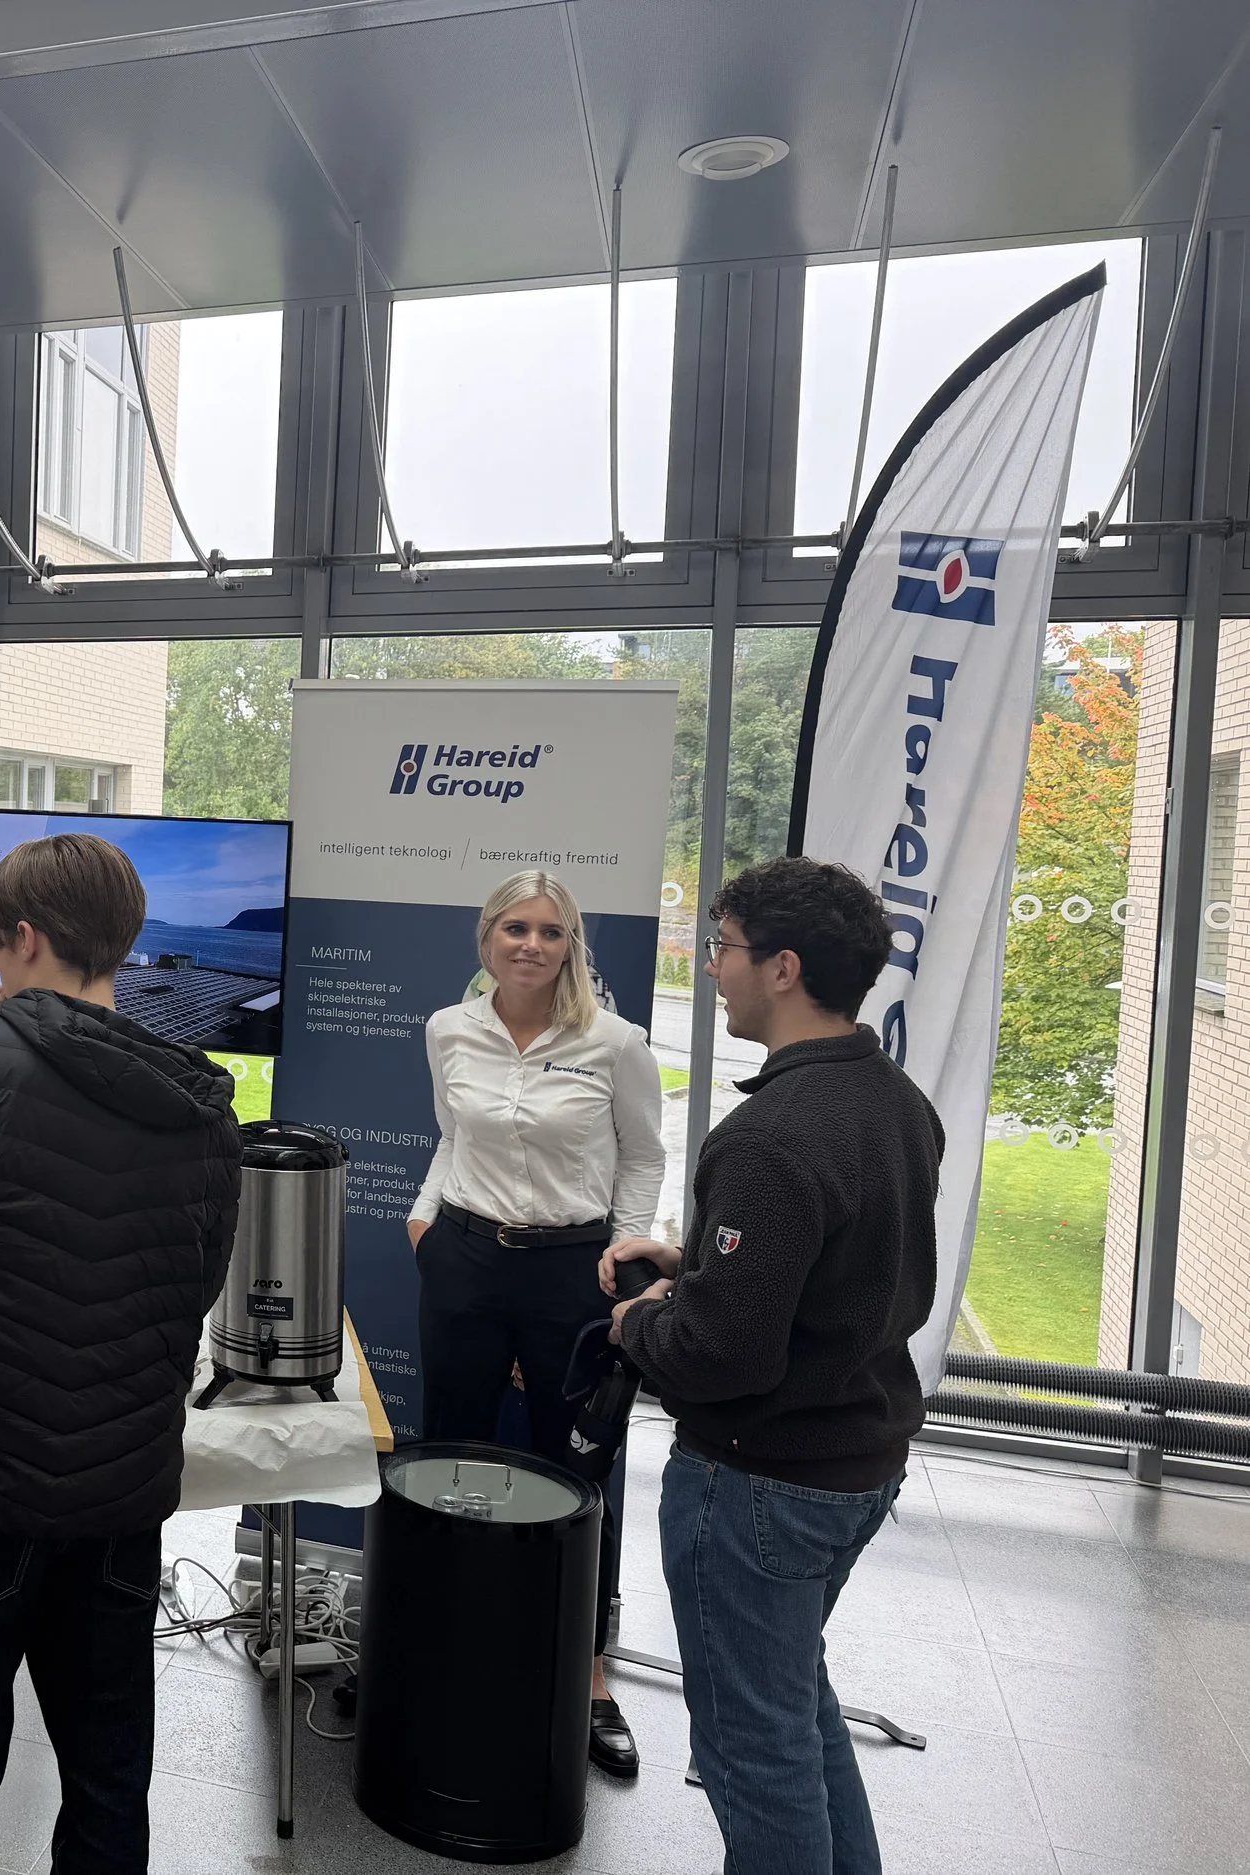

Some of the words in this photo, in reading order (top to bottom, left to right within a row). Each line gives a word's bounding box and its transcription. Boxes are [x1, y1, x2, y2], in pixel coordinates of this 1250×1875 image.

[433, 744, 541, 769] Hareid
[426, 774, 525, 804] Group
[319, 841, 385, 857] intelligent
[389, 844, 452, 860] teknologi
[480, 848, 562, 866] bærekraftig
[566, 851, 619, 866] fremtid
[311, 946, 372, 962] MARITIM
[309, 977, 333, 988] Hele
[336, 979, 387, 993] spekteret
[389, 984, 402, 993] av
[307, 992, 386, 1007] skipselektriske
[307, 1006, 380, 1022] installasjoner,
[306, 1021, 343, 1033] system
[345, 1025, 360, 1036] og
[363, 1025, 412, 1039] tjenester.
[340, 1127, 362, 1141] OG
[366, 1129, 433, 1149] INDUSTRI
[354, 1160, 407, 1175] elektriske
[372, 1178, 415, 1192] produkt
[347, 1189, 362, 1199] for
[370, 1207, 384, 1219] og
[254, 1303, 286, 1313] CATERING
[372, 1345, 410, 1360] utnytte
